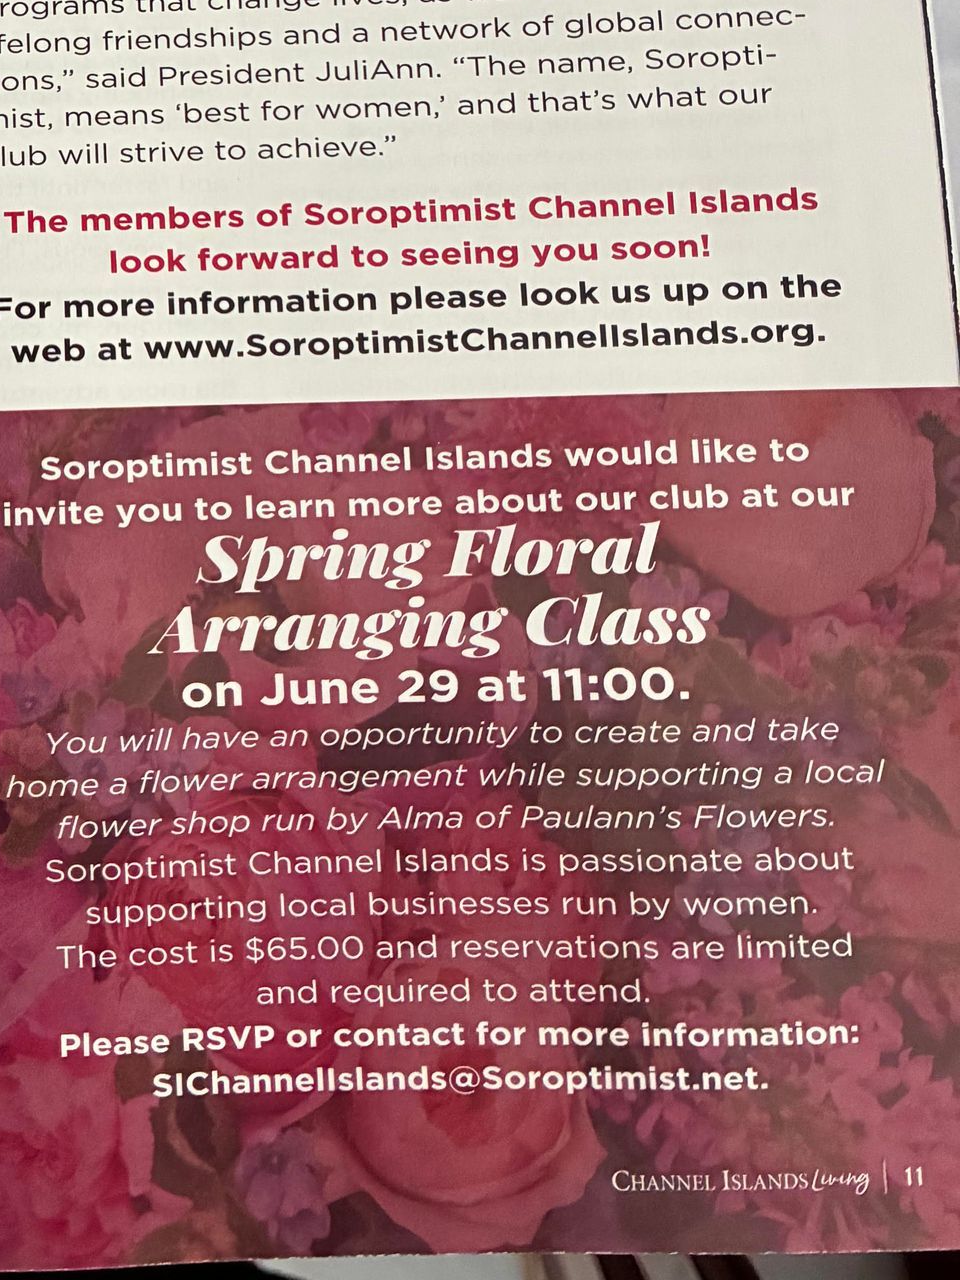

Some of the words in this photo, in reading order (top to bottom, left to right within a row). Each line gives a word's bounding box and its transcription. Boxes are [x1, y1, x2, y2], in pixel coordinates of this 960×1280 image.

[86, 66, 146, 88] said
[159, 63, 304, 86] President
[316, 60, 441, 81] JuliAnn.
[454, 55, 526, 76] “The
[539, 56, 632, 74] name,
[646, 44, 776, 71] Soropti-
[4, 210, 68, 233] The
[81, 206, 244, 231] members
[256, 203, 292, 227] of
[305, 198, 516, 228] Soroptimist
[529, 192, 675, 219] Channel
[689, 187, 818, 214] Islands
[11, 338, 85, 363] web
[98, 338, 132, 361] at
[144, 320, 825, 360] www.SoroptimistChannelIslands.org.
[41, 451, 252, 483] Soroptimist
[265, 447, 411, 474] Channel
[426, 443, 552, 470] Islands
[564, 440, 677, 466] would
[692, 438, 756, 463] like
[769, 439, 809, 462] to
[4, 500, 104, 526] invite
[116, 503, 182, 528] you
[194, 498, 232, 520] to
[246, 495, 335, 519] learn
[349, 496, 442, 516] more
[456, 489, 563, 514] about
[576, 491, 636, 511] our
[650, 484, 728, 509] club
[742, 484, 778, 507] at
[792, 487, 854, 507] our
[196, 528, 431, 593] Spring
[443, 520, 660, 577] Floral
[147, 596, 509, 660] Arranging
[526, 592, 711, 646] Class
[182, 681, 242, 708] on
[260, 673, 379, 705] June
[398, 669, 458, 703] 29
[478, 670, 526, 702] at
[542, 667, 689, 701] 11:00.
[58, 815, 162, 839] flower
[171, 811, 250, 837] shop
[262, 814, 314, 831] run
[327, 807, 368, 835] by
[377, 806, 463, 829] Alma
[476, 805, 513, 829] of
[521, 805, 682, 829] Paulann’s
[694, 804, 833, 828] Flowers.
[56, 944, 117, 969] The
[129, 941, 198, 966] cost
[210, 939, 233, 962] is
[246, 936, 363, 964] $65.00
[376, 934, 437, 959] and
[451, 935, 658, 959] reservations
[672, 941, 724, 959] are
[737, 932, 852, 959] limited
[61, 1032, 170, 1057] Please
[182, 1025, 274, 1051] RSVP
[286, 1029, 322, 1048] or
[334, 1023, 465, 1047] contact
[476, 1021, 526, 1045] for
[539, 1027, 629, 1046] more
[642, 1021, 859, 1047] information:
[153, 1065, 768, 1098] SIChannelIslands@Soroptimist.net.
[905, 1166, 923, 1187] 11
